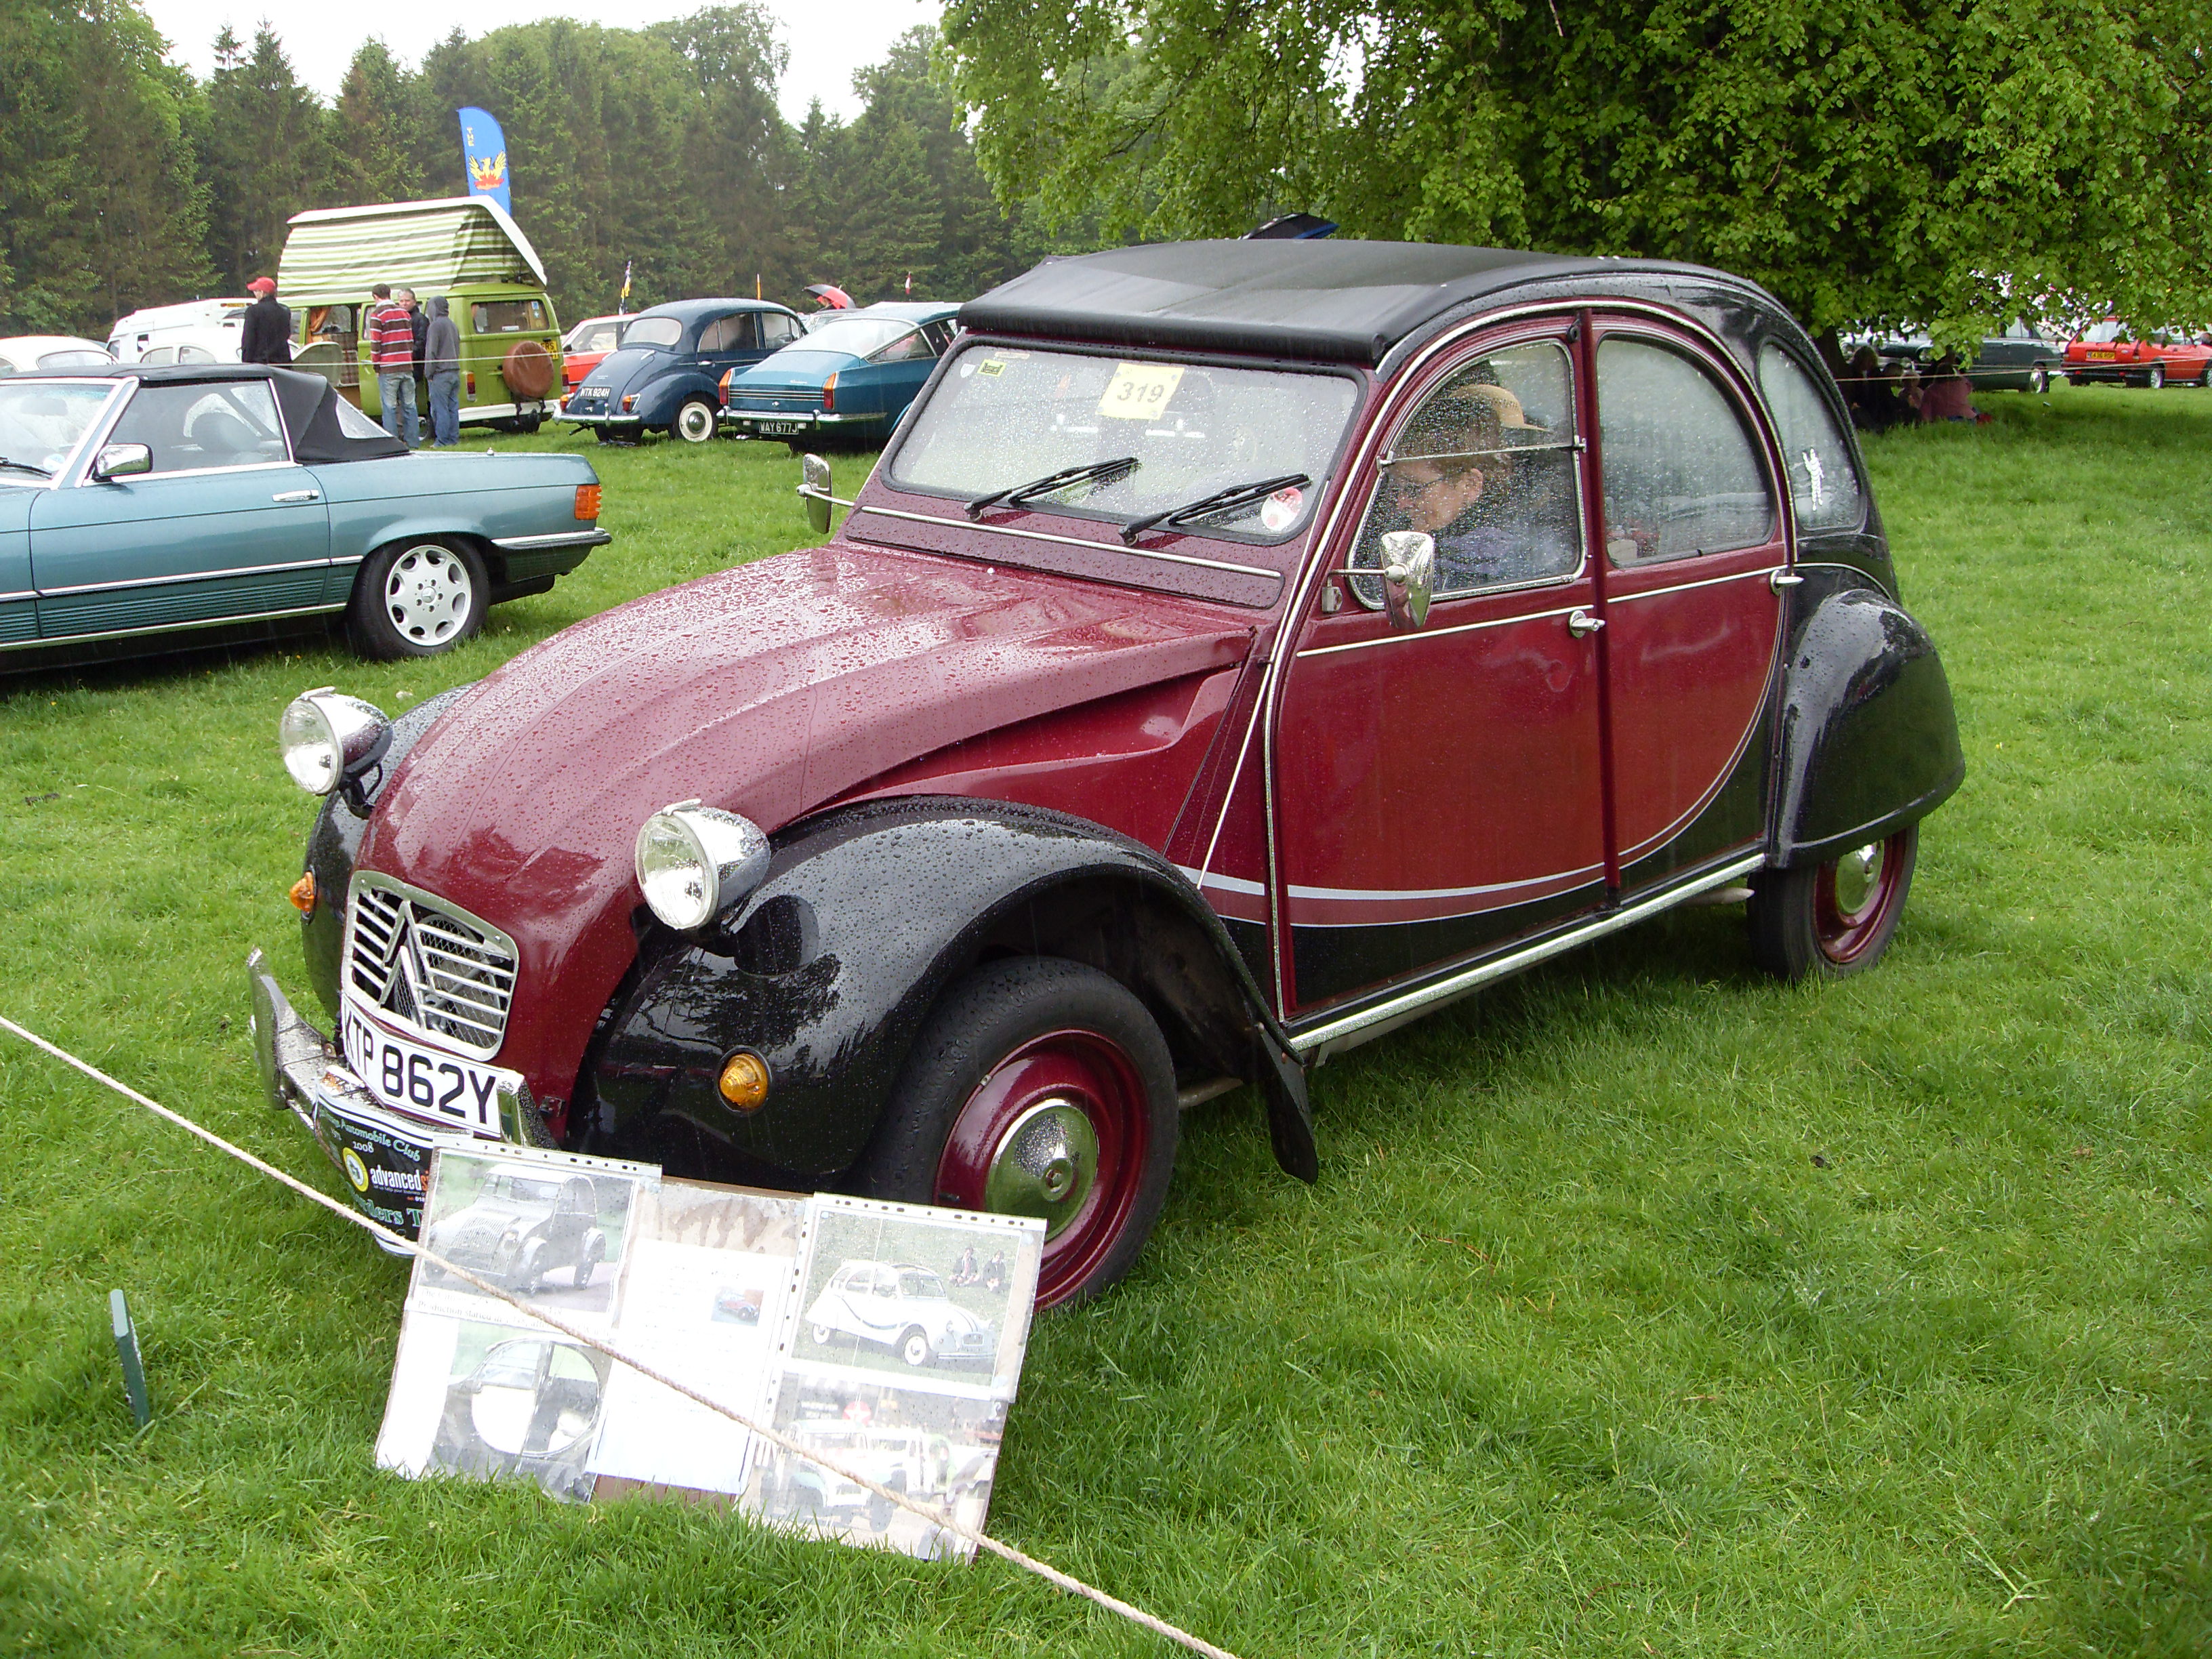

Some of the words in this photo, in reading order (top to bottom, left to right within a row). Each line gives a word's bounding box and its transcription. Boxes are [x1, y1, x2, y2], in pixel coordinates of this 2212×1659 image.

[466, 127, 474, 147] THE
[593, 388, 610, 397] 924H
[1117, 382, 1164, 403] 319
[776, 422, 797, 433] 677J
[344, 1001, 373, 1076] KTP
[382, 1044, 496, 1124] 862Y
[341, 1118, 391, 1147] Automobile
[393, 1140, 421, 1162] Club
[352, 1141, 374, 1153] 2008
